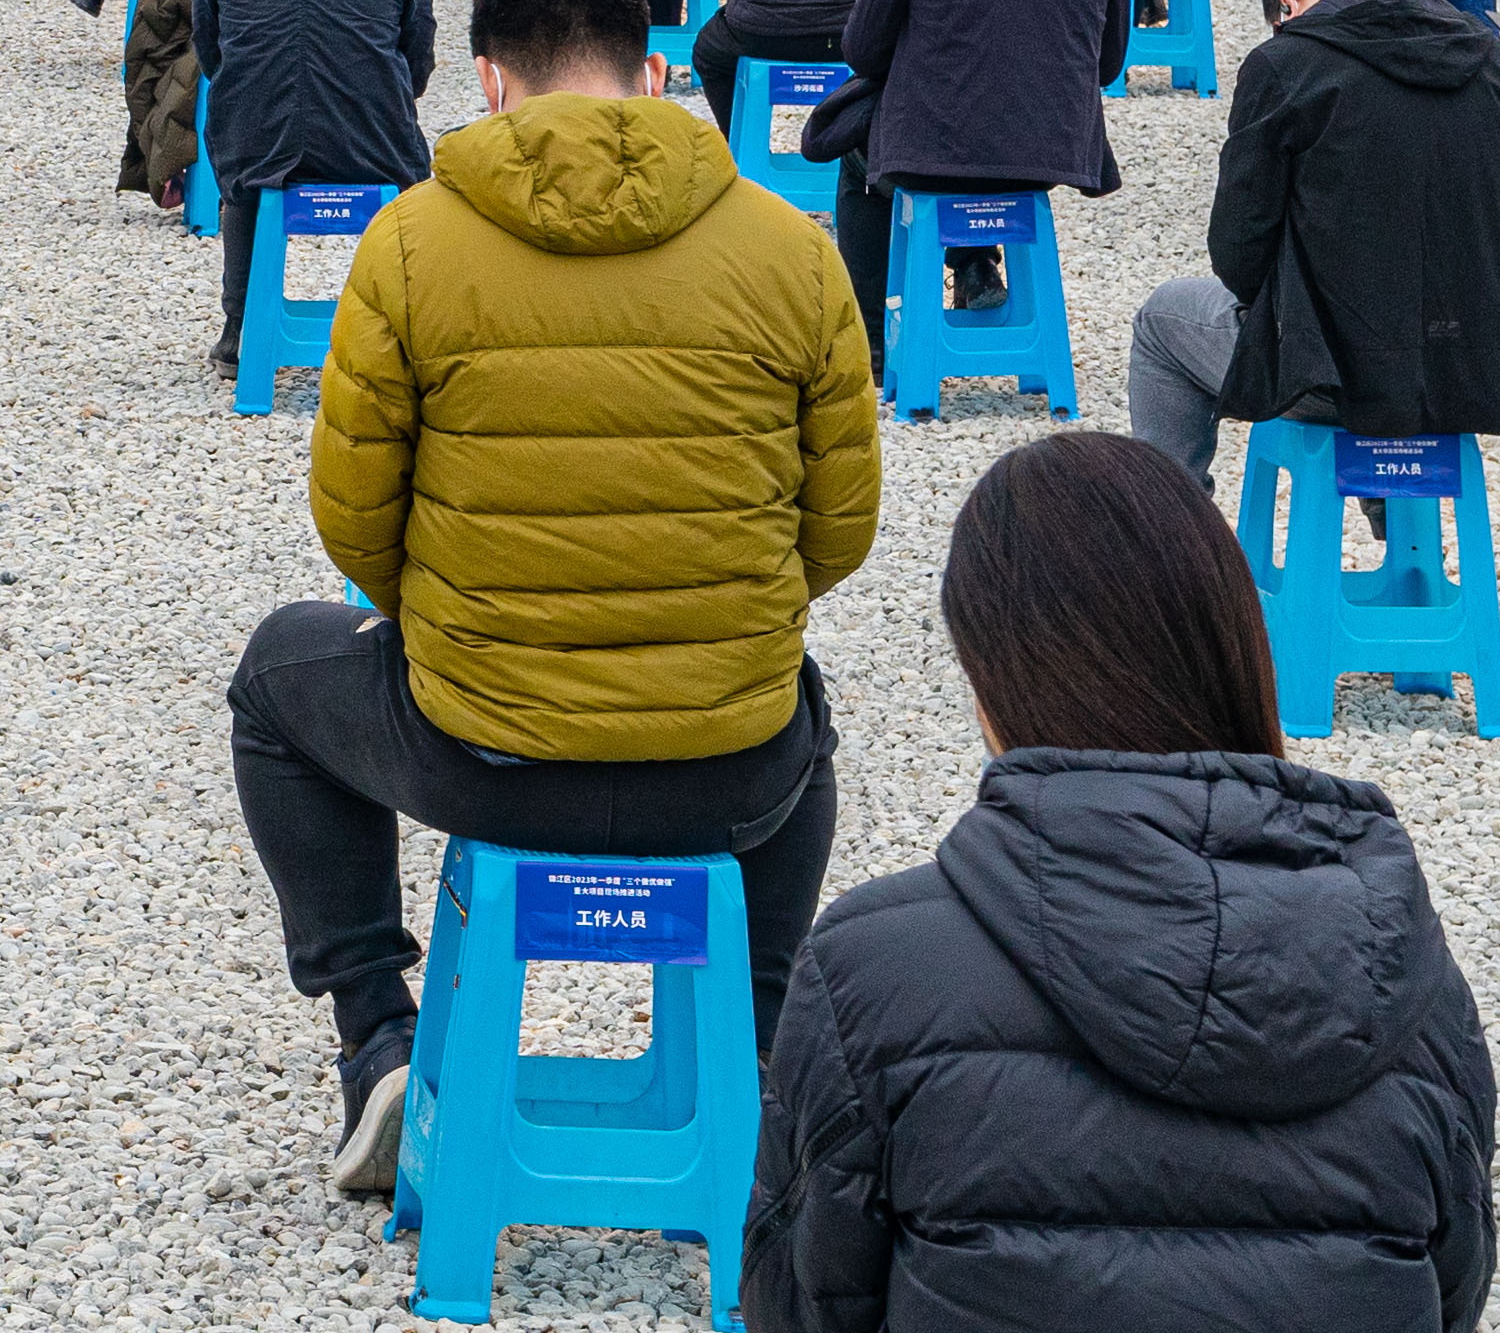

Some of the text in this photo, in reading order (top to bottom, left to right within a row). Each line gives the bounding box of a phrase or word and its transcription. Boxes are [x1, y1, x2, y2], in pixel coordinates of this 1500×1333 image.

[314, 209, 350, 218] 工作人员
[969, 219, 1004, 228] 工作人员
[1376, 463, 1421, 475] 工作人员
[576, 910, 646, 928] 工作人员
